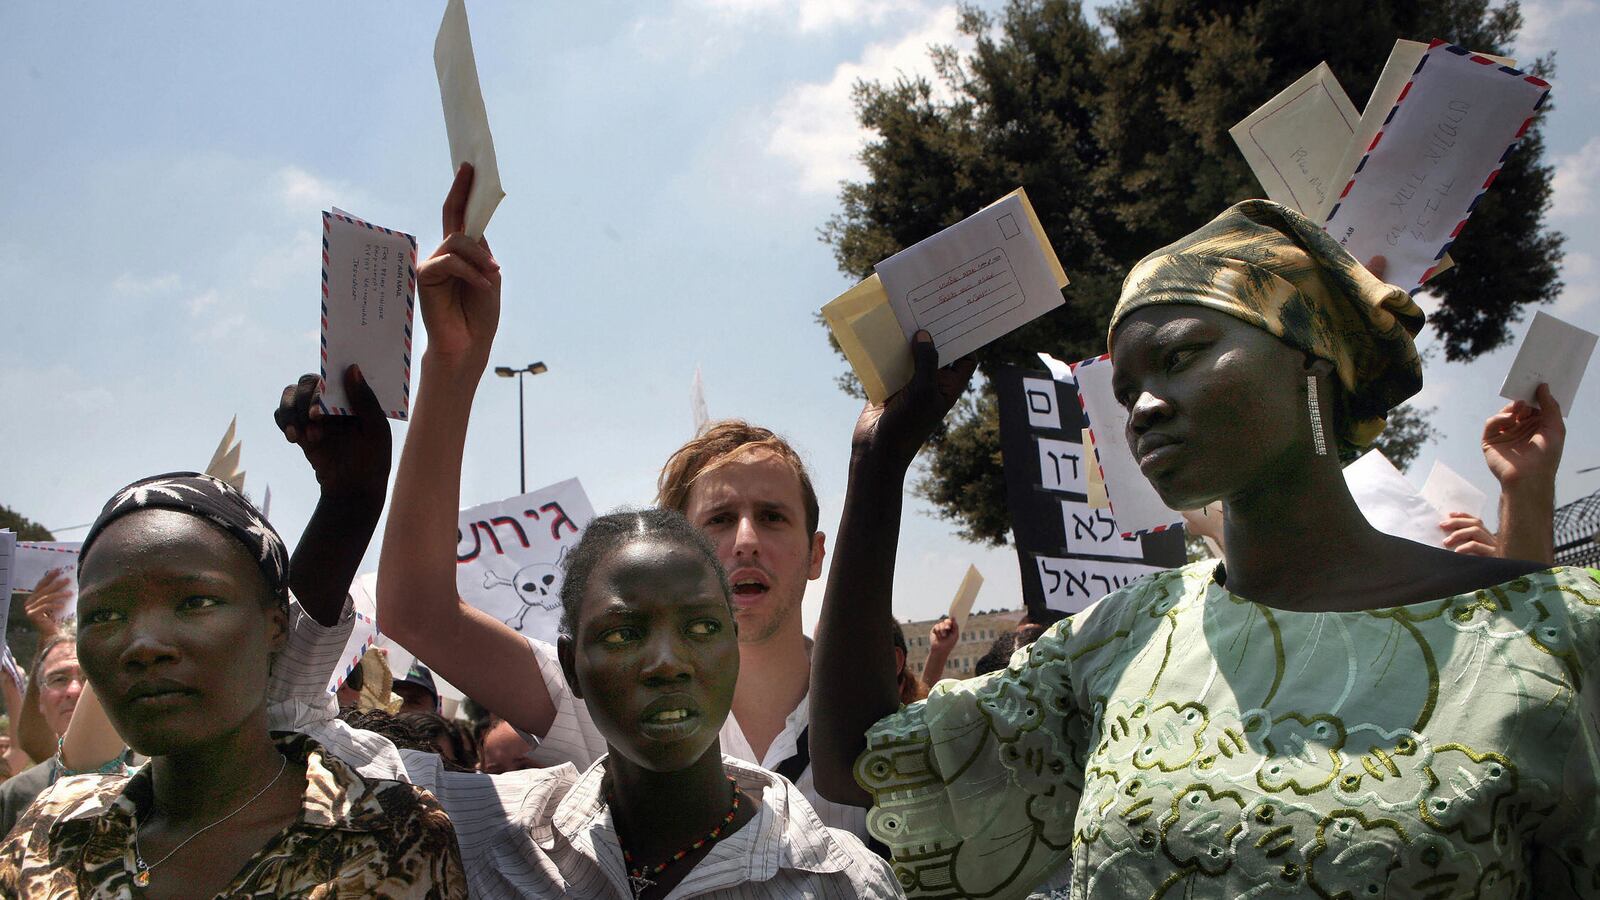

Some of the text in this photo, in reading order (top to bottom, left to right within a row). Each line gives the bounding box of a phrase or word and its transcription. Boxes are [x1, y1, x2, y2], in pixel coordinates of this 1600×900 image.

[394, 252, 404, 298] BY AIR MAIL
[1072, 508, 1138, 542] לא
[1042, 560, 1144, 598] ראל
